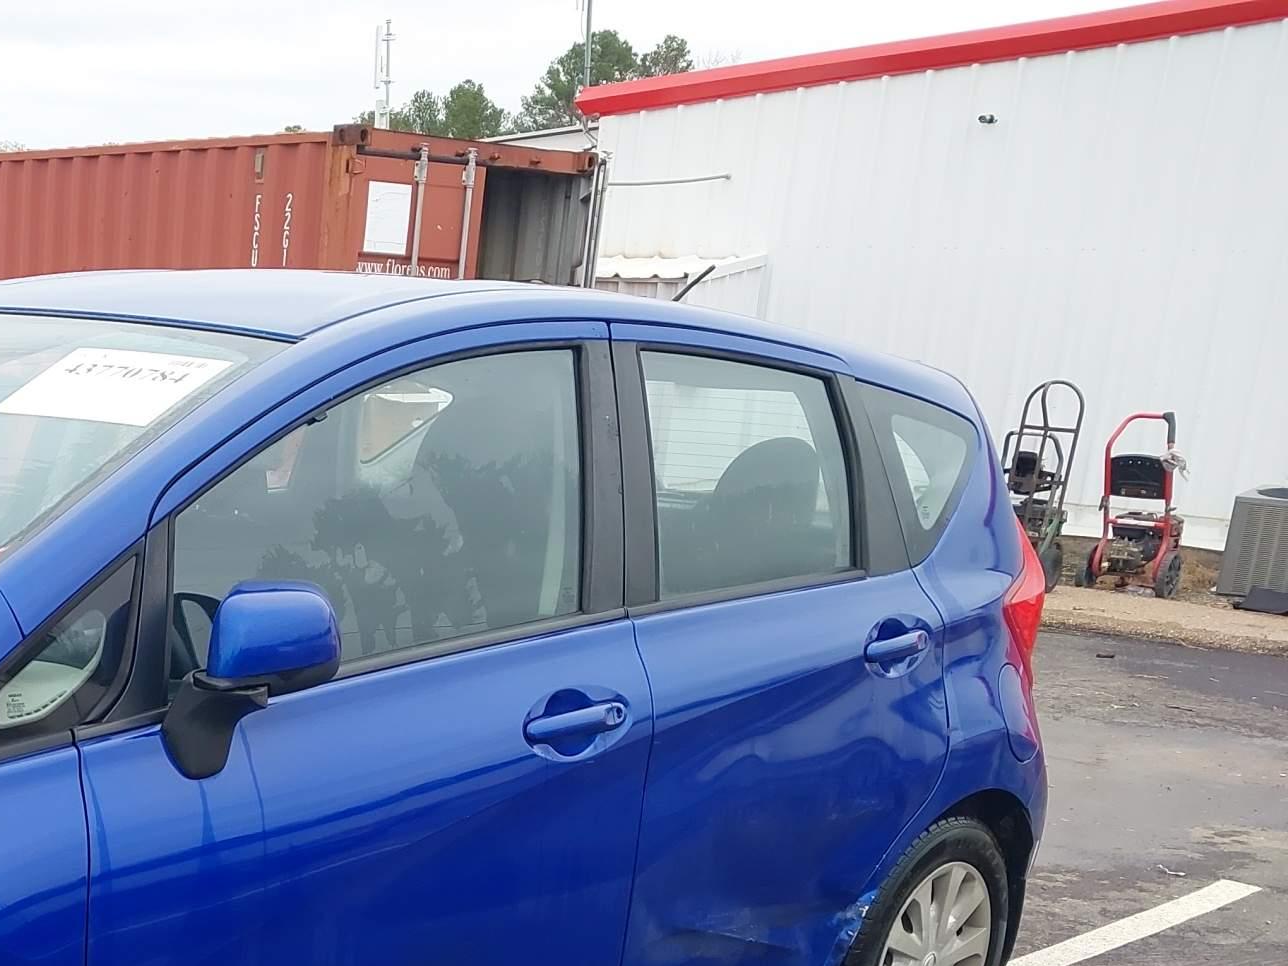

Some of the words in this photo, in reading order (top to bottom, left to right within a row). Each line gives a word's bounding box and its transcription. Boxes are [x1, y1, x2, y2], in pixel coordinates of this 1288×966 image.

[251, 194, 262, 268] FSCU
[281, 193, 293, 267] 22G1
[356, 258, 451, 279] wwwflorescom
